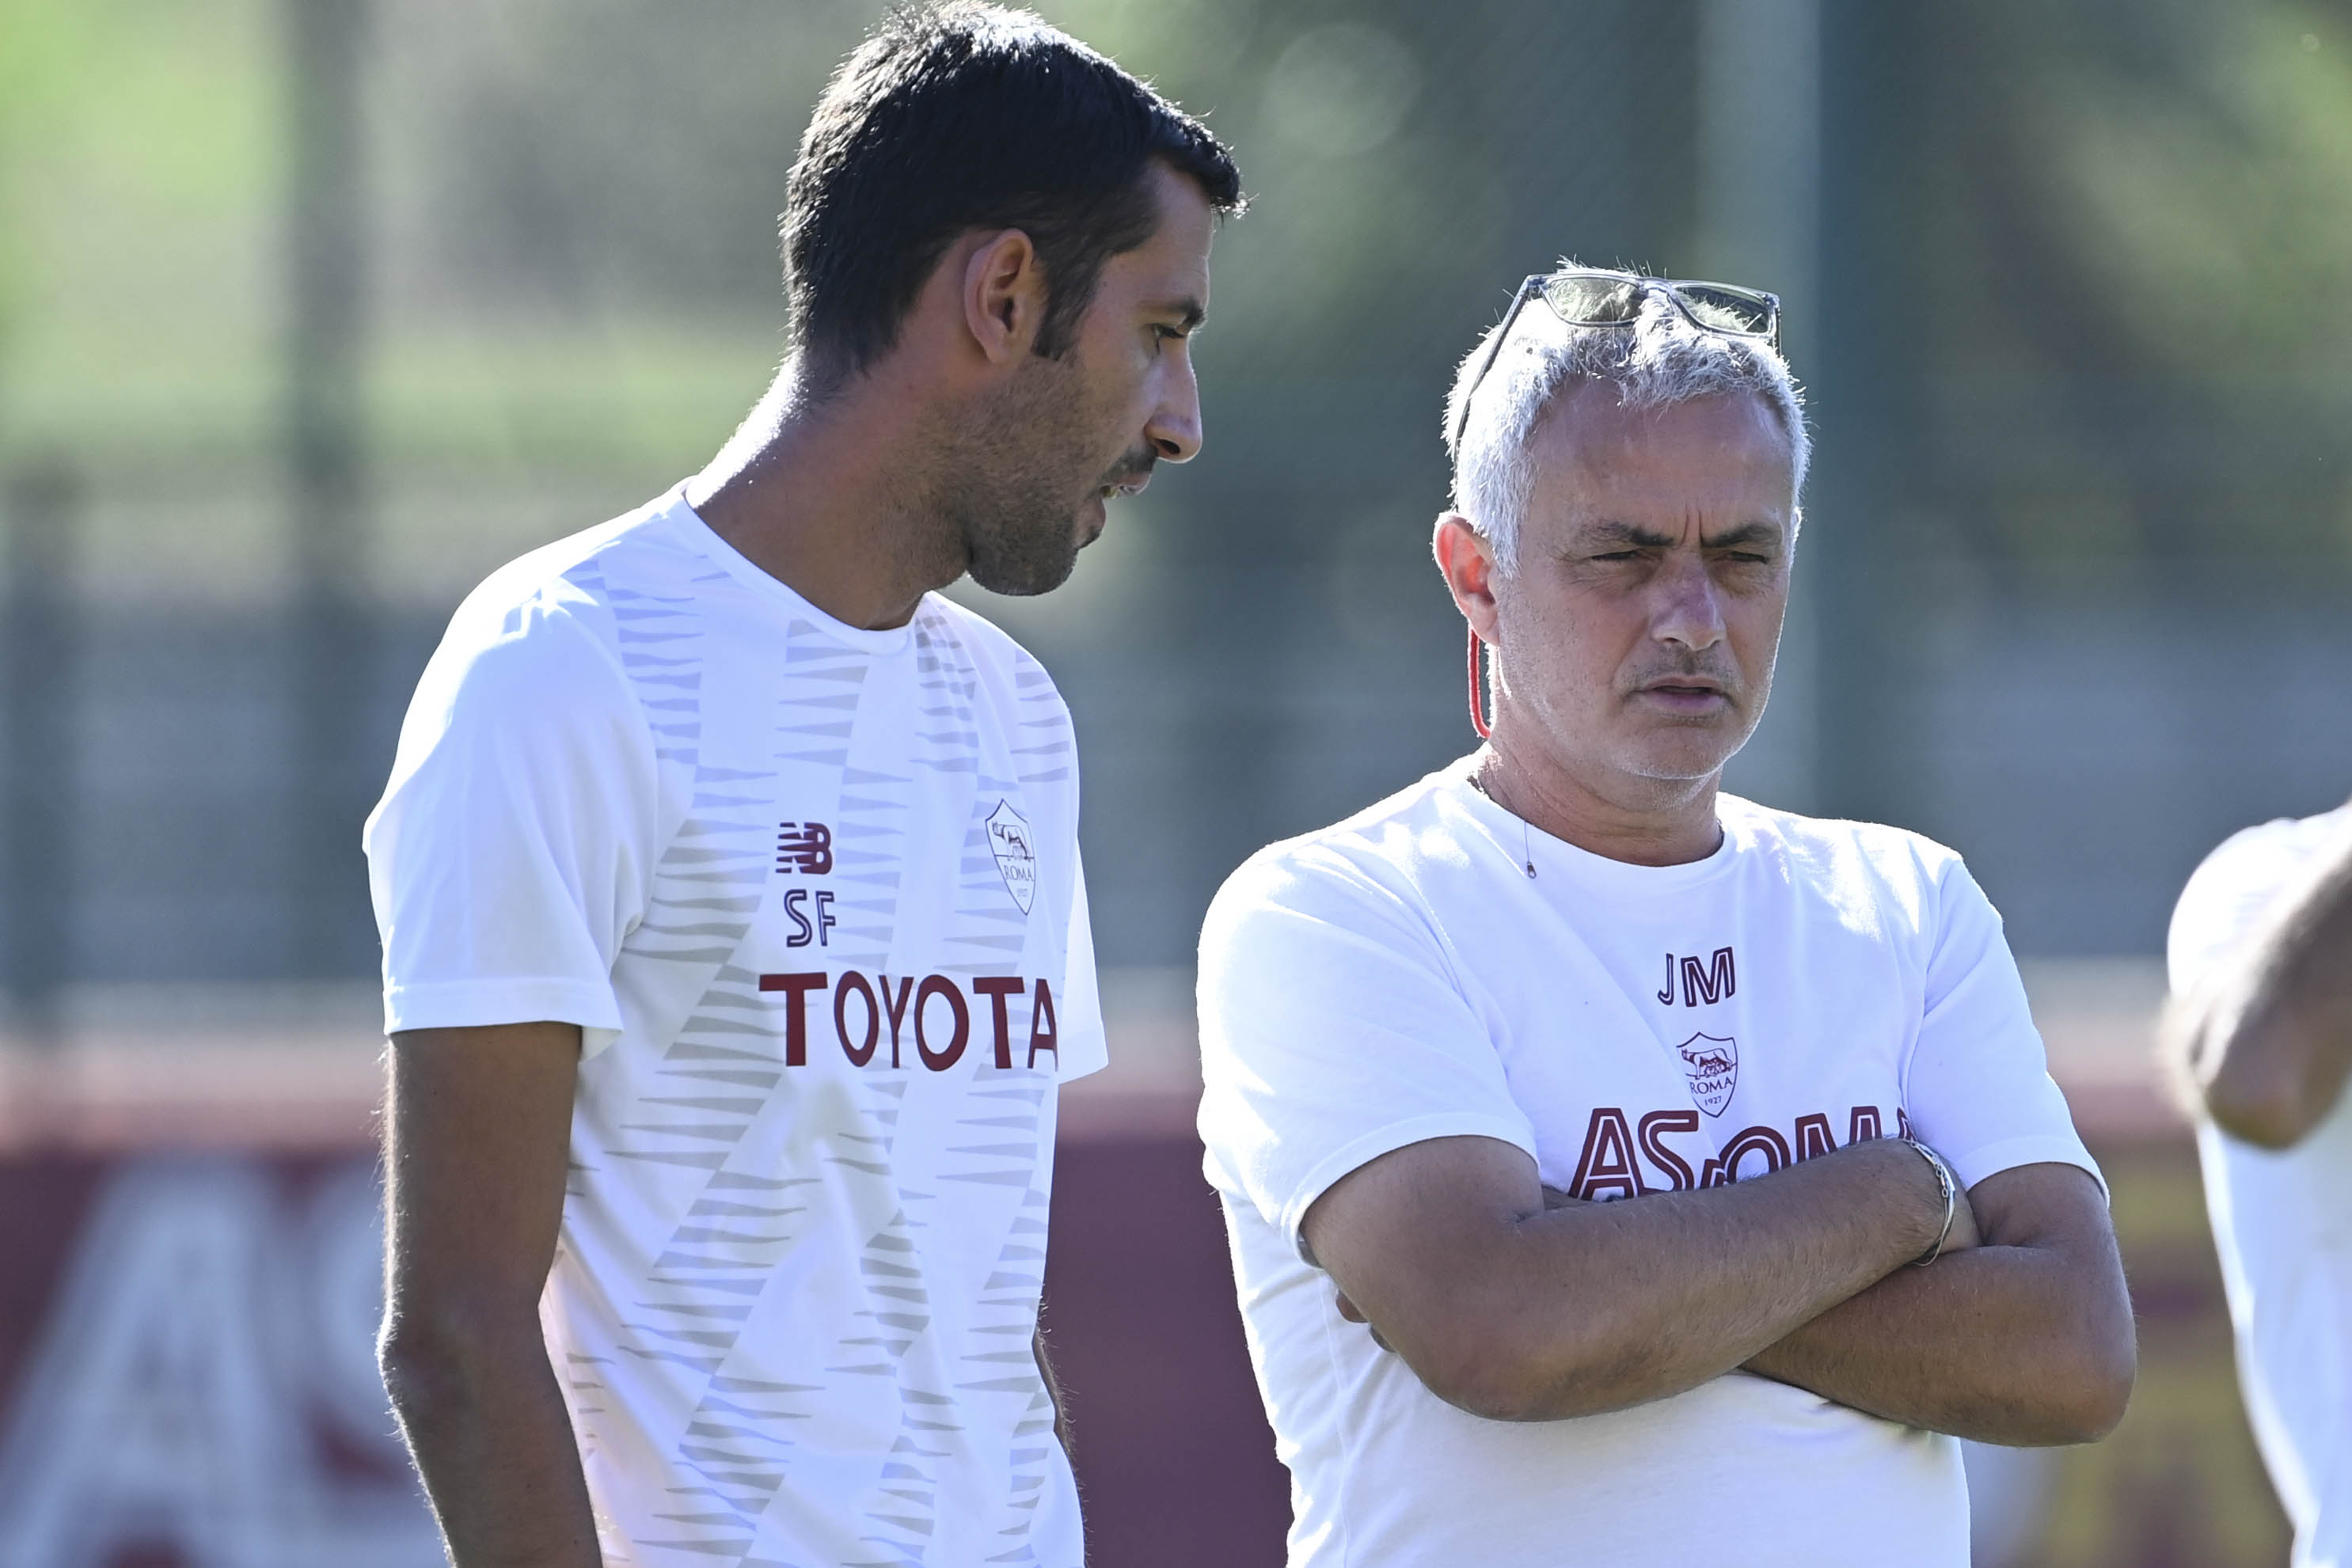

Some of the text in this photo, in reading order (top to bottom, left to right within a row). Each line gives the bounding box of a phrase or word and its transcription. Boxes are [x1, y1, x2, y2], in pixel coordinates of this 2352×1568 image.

[1003, 864, 1035, 882] ROMA
[784, 888, 836, 948] SF
[1657, 946, 1735, 1008] JM
[758, 970, 1059, 1072] TOYOTA
[1689, 1076, 1733, 1095] ROMA
[1704, 1095, 1722, 1107] 1927
